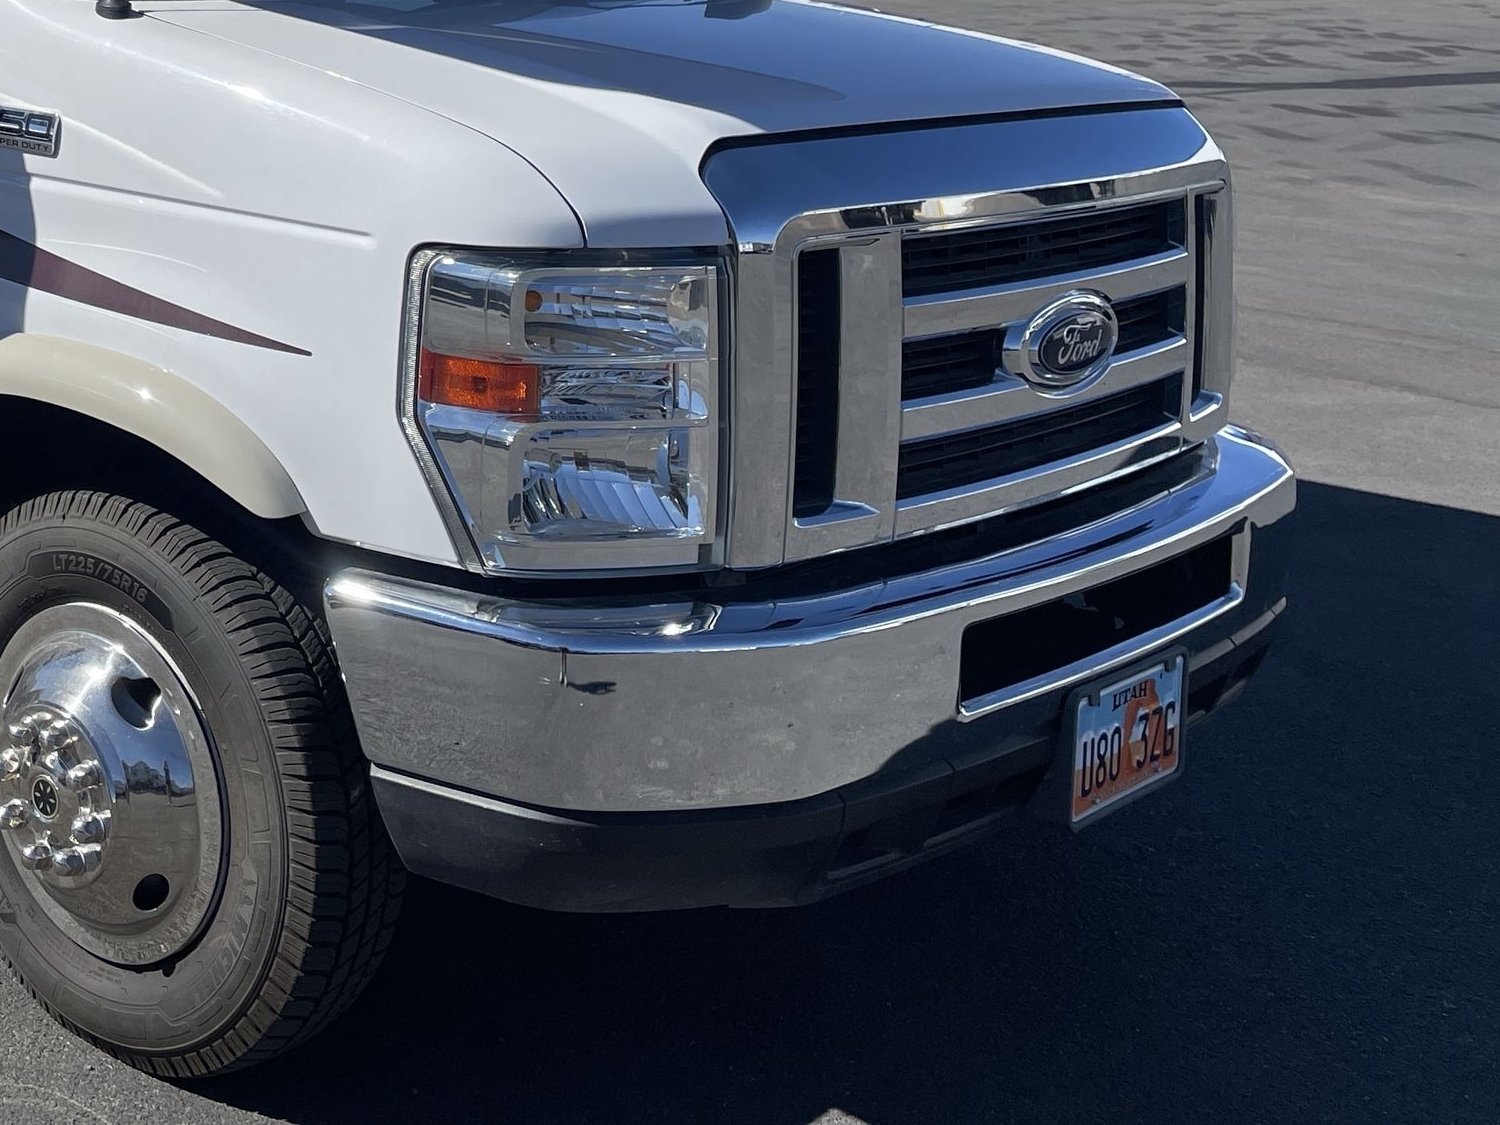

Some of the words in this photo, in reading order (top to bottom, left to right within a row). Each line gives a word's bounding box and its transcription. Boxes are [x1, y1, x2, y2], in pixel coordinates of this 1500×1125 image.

[21, 139, 50, 153] DUTY
[1057, 324, 1103, 365] Ford
[52, 553, 149, 603] LT225/75R16
[1111, 680, 1149, 712] UTAH
[1080, 725, 1123, 798] U80
